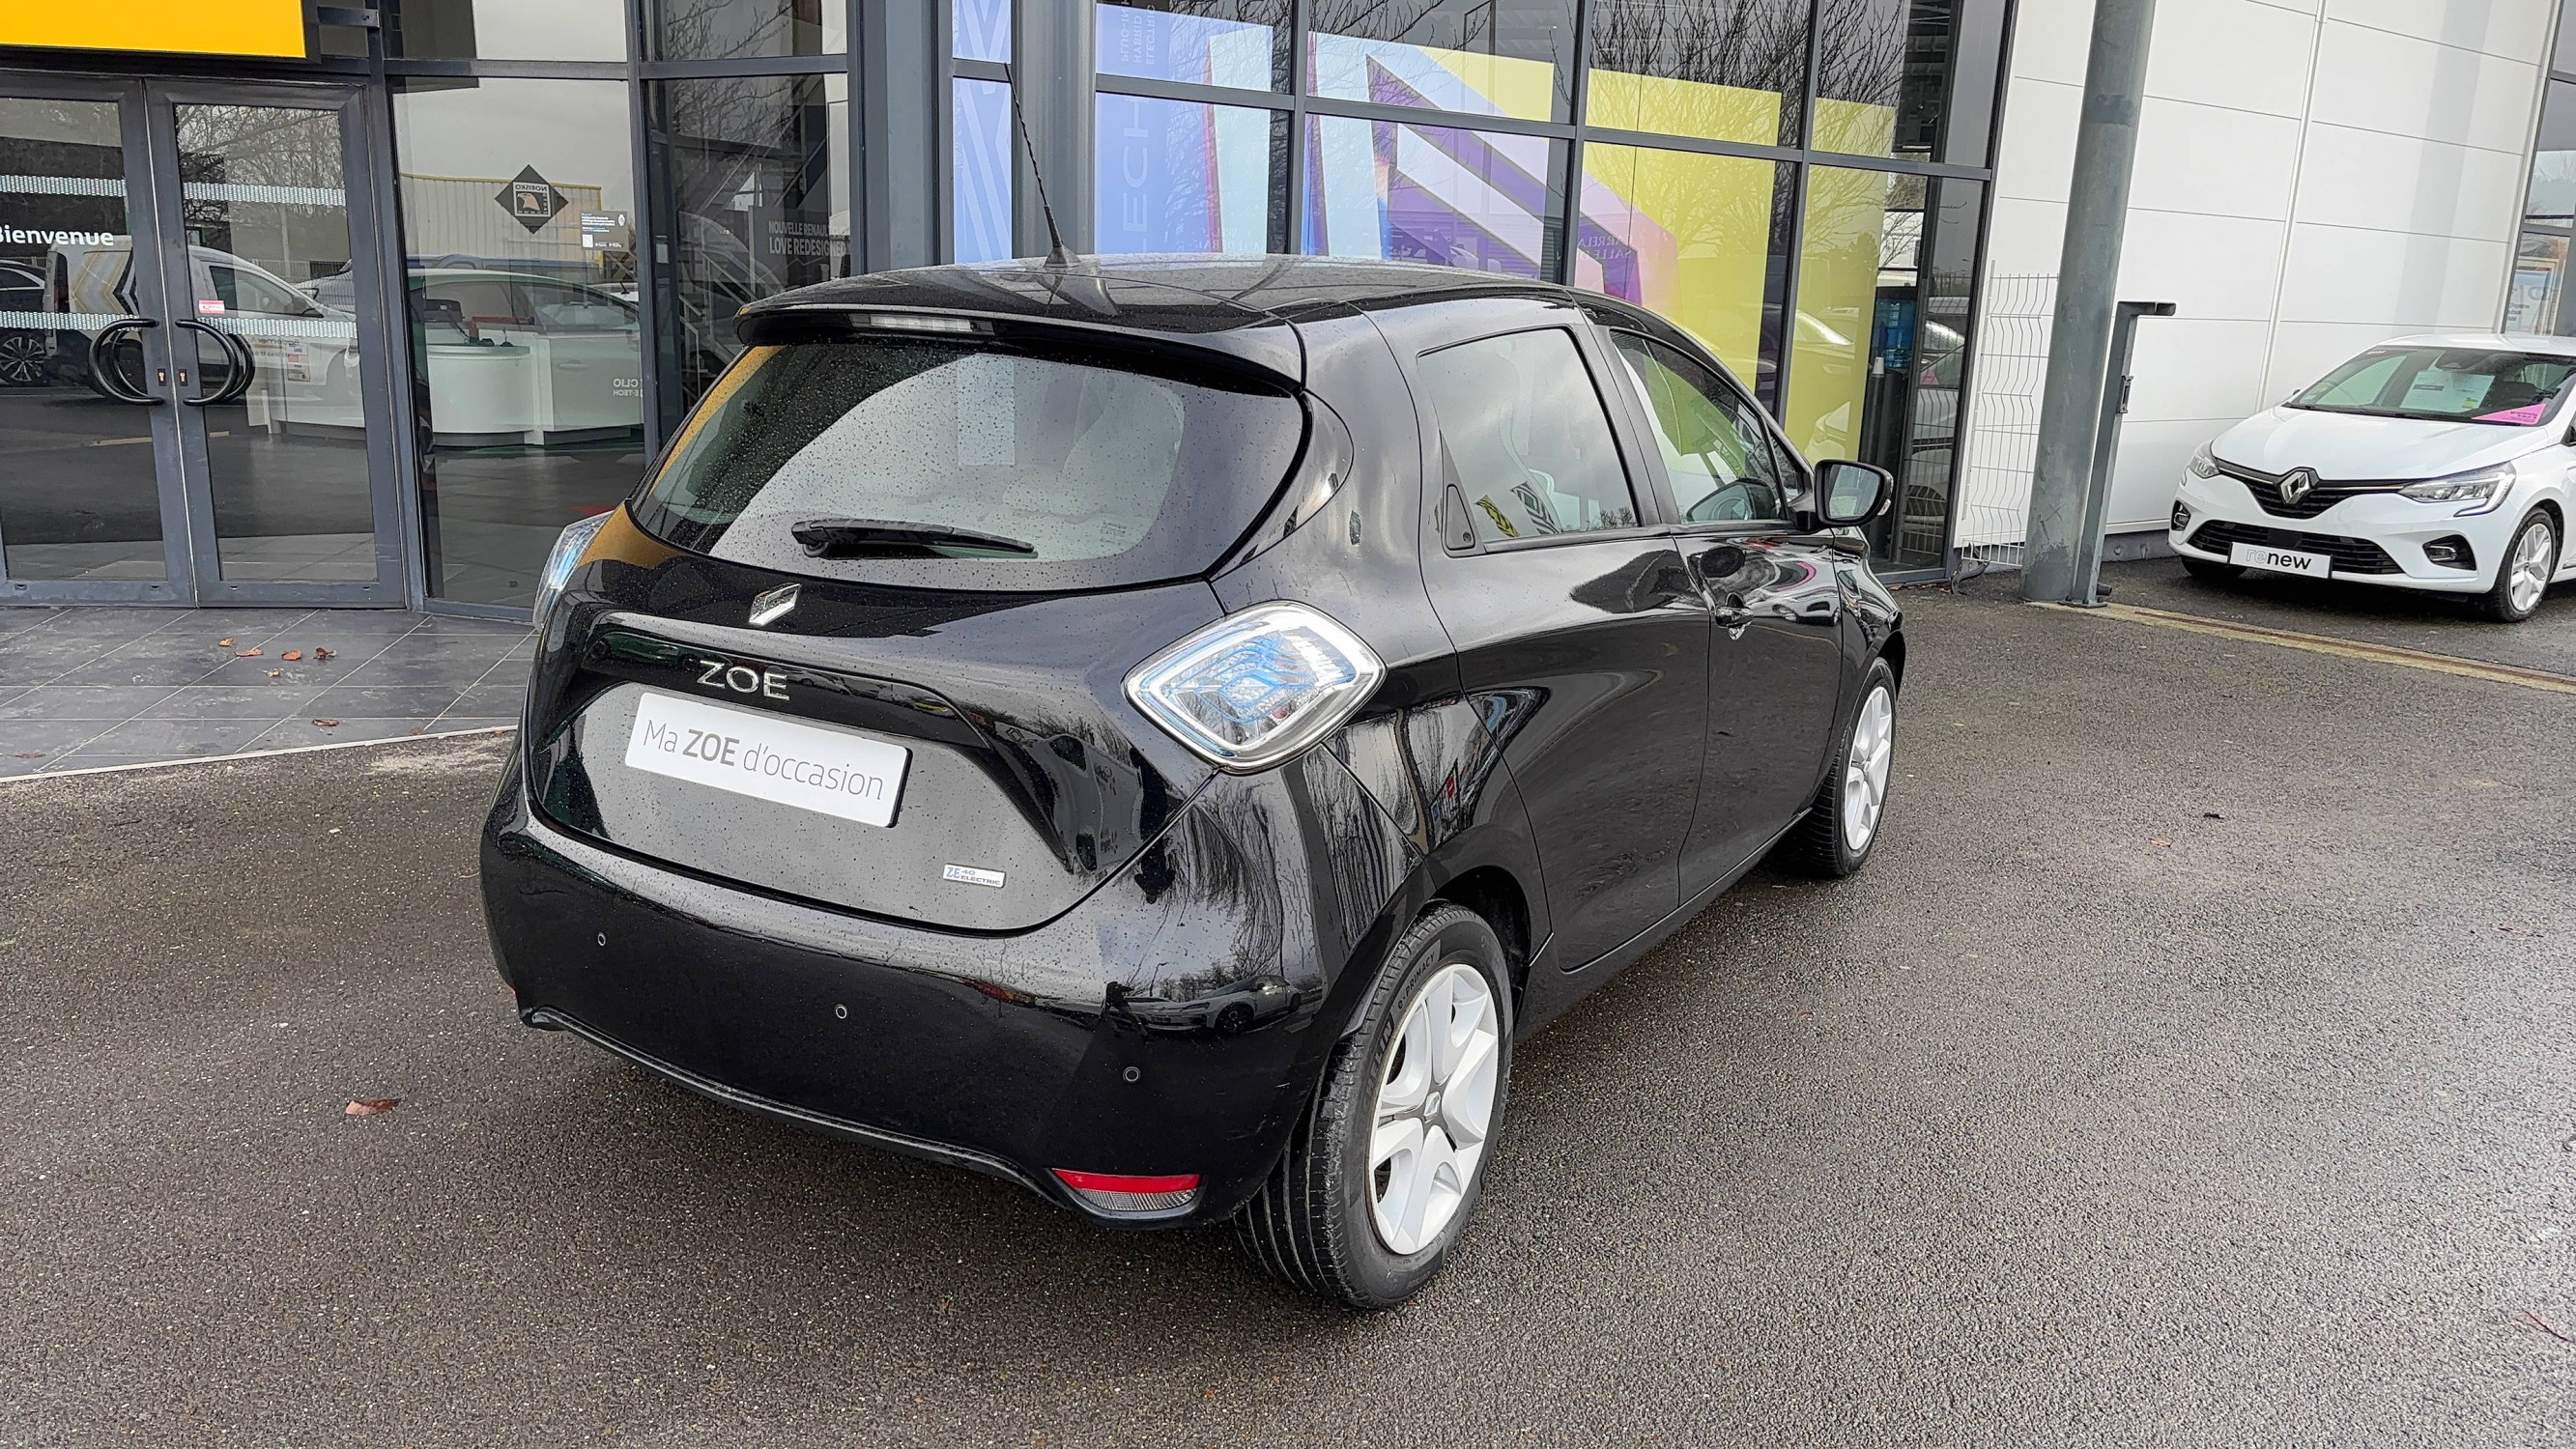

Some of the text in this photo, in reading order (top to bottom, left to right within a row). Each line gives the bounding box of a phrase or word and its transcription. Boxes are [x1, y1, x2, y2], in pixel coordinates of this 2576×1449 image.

[768, 220, 803, 236] NOUVELLE
[803, 222, 831, 239] RENAUL
[769, 237, 846, 257] LOVE REDESIGNED
[2246, 549, 2312, 570] renew
[697, 659, 790, 701] ZOE
[644, 719, 884, 800] Ma ZOE d'occasion
[960, 875, 1001, 886] ELECTRIC
